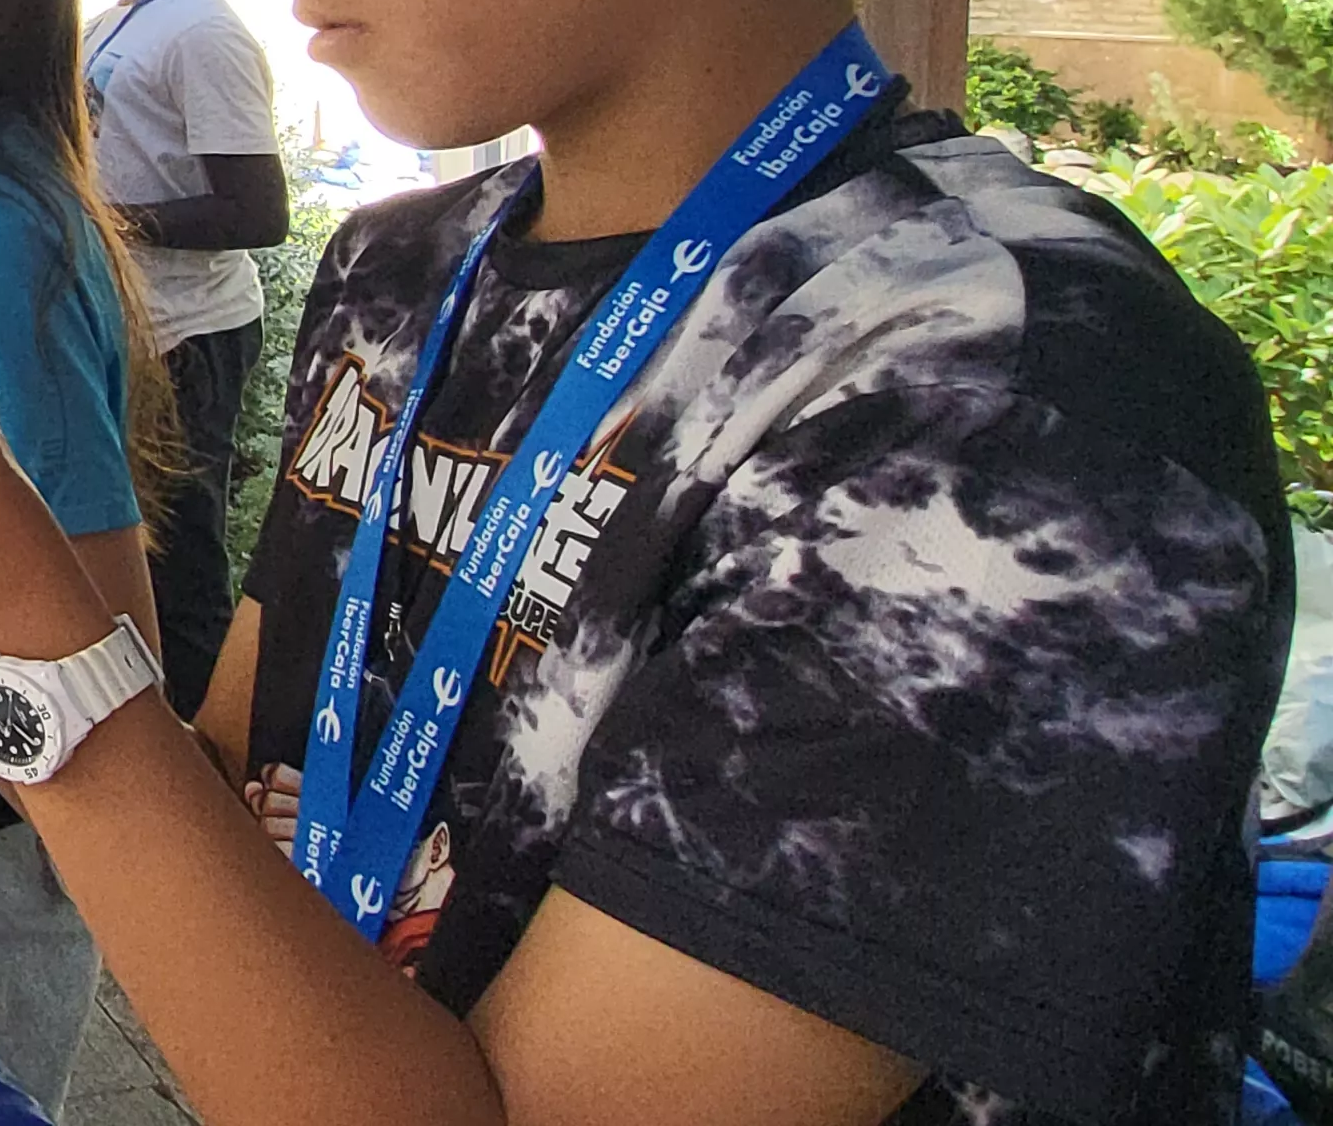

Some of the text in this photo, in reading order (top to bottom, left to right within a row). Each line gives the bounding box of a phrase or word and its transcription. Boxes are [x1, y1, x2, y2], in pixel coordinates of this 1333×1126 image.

[731, 90, 813, 166] Fundación
[576, 281, 643, 369] Fundación
[458, 496, 512, 585] Fundación
[37, 703, 52, 721] 30
[369, 710, 415, 795] Fundación
[302, 820, 328, 887] iberC
